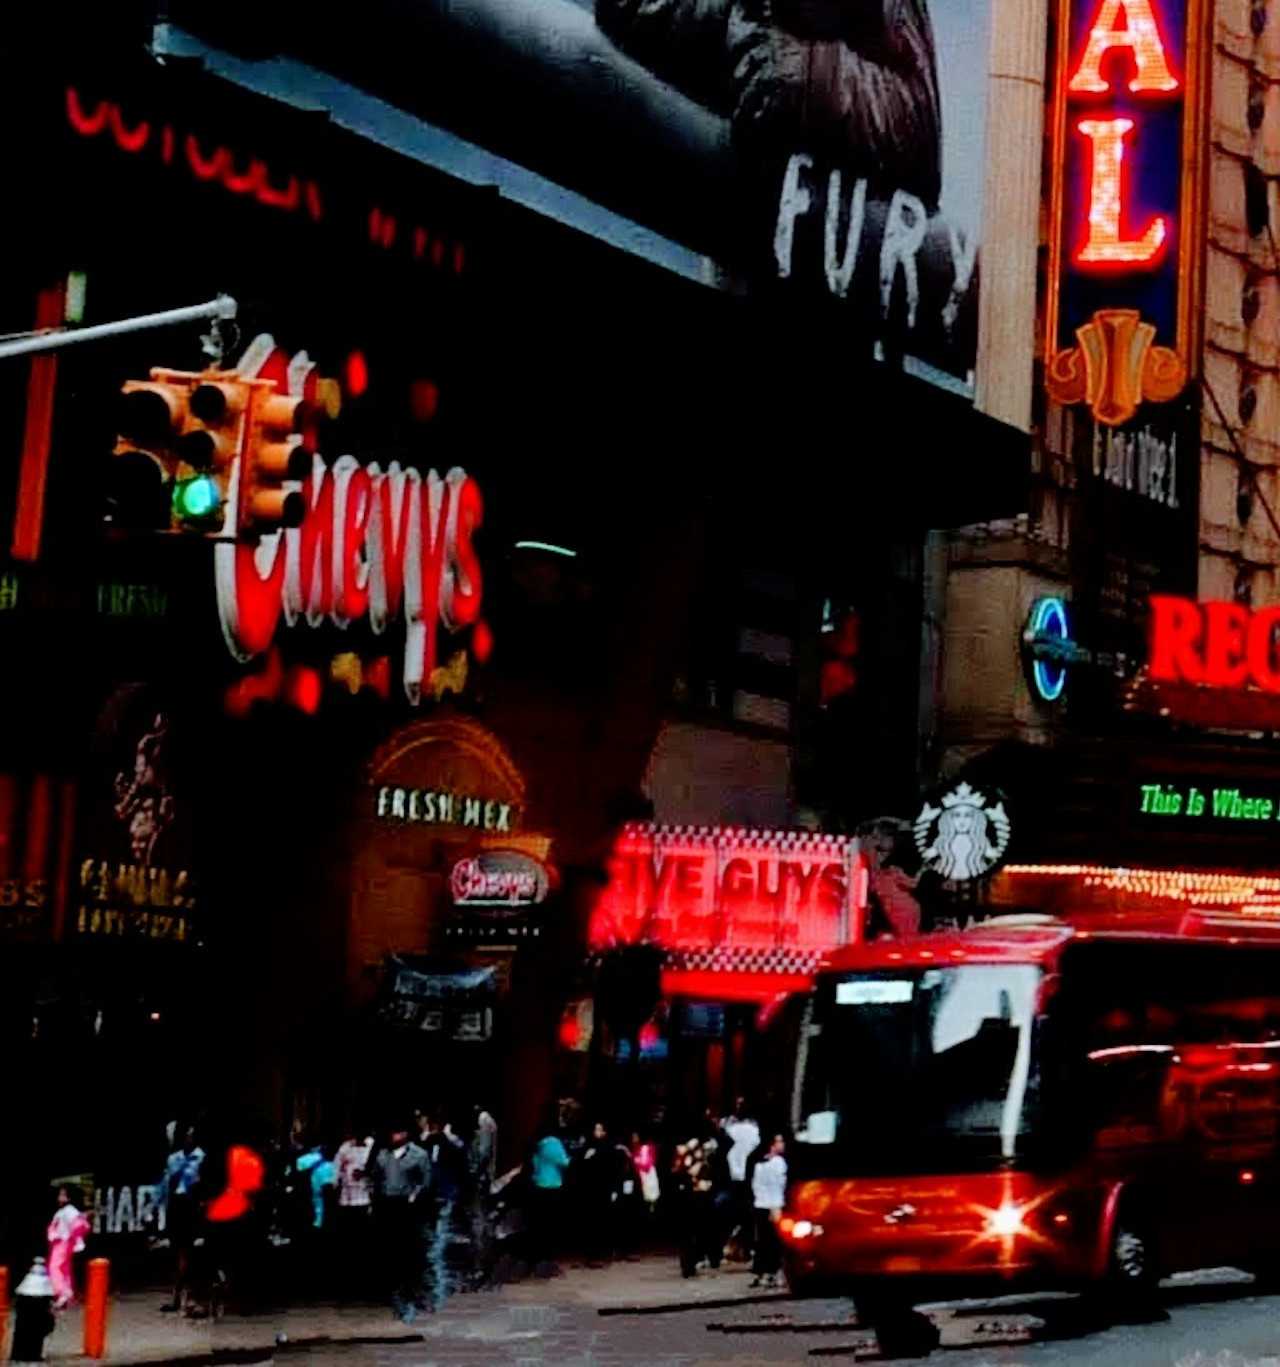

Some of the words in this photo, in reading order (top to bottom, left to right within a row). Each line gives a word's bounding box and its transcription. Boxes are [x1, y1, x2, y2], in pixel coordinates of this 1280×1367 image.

[773, 153, 981, 332] FURY
[377, 786, 453, 822] FRESH
[463, 797, 511, 832] MEX
[1140, 784, 1182, 814] This
[1186, 787, 1205, 816] Is
[1212, 788, 1273, 820] Where
